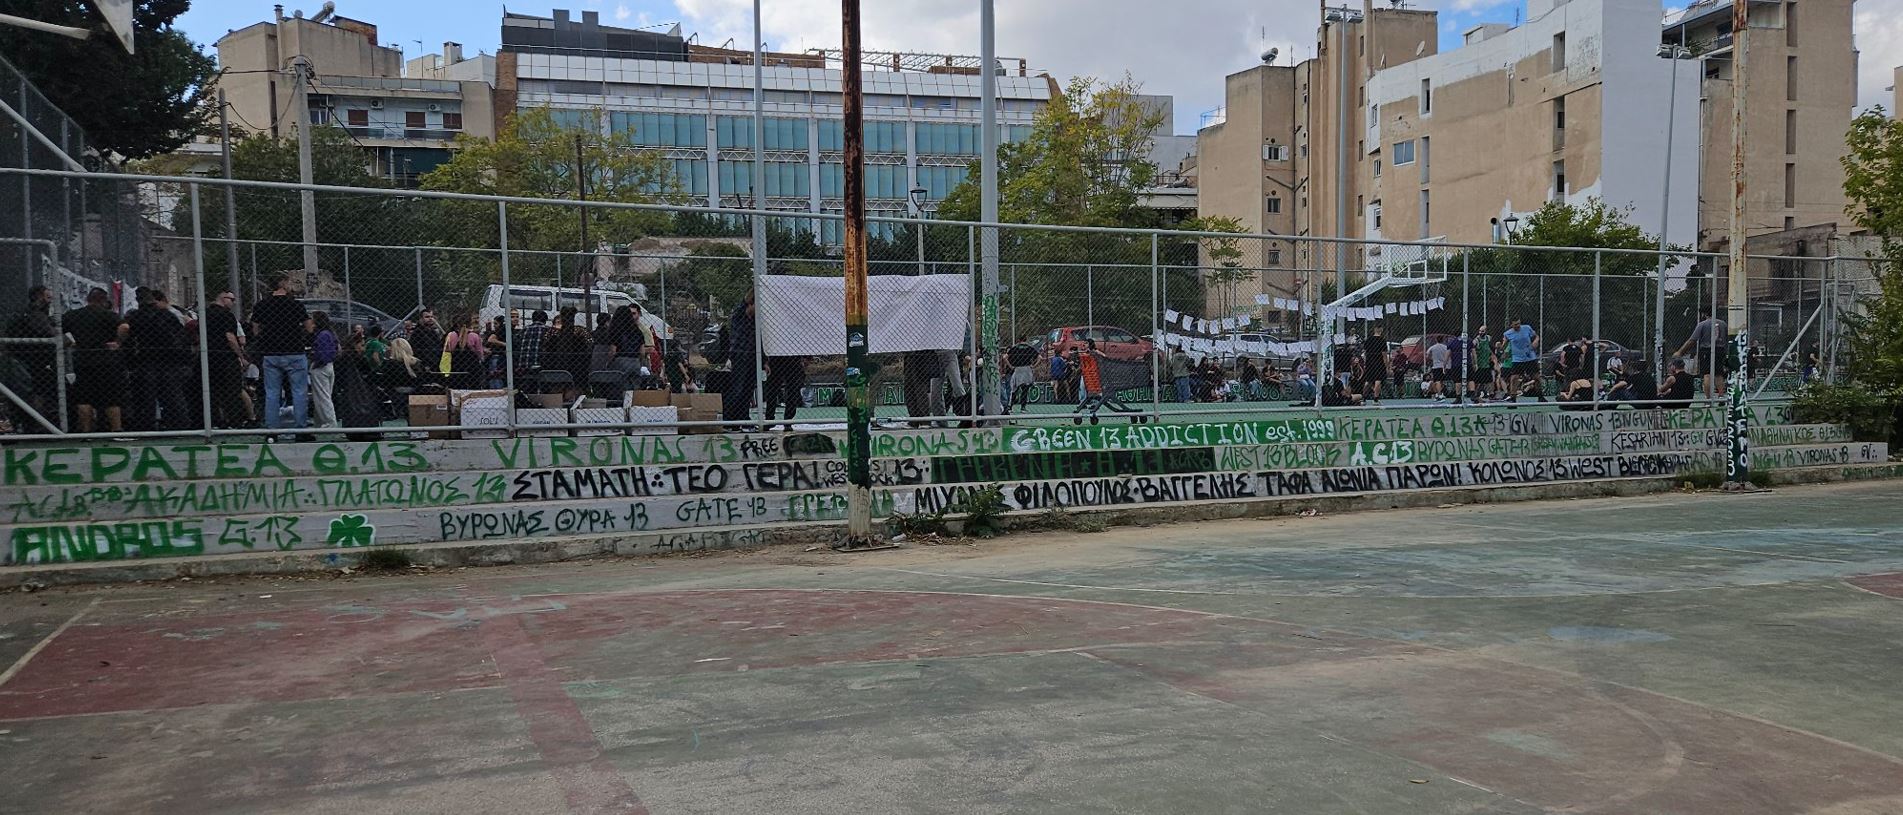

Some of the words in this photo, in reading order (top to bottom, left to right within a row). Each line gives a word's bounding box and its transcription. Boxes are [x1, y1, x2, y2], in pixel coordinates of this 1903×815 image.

[1010, 428, 1092, 452] GREEN
[1099, 426, 1120, 449] 13
[1125, 421, 1259, 448] ADDICTION
[1302, 419, 1334, 440] 1999
[1338, 416, 1426, 441] ΚΕΡΑΤΕΑ
[1549, 413, 1603, 433] VIRONAS
[4, 443, 294, 485] ΚΕΡΑΤΕΑ
[492, 436, 686, 469] VIRONAS
[702, 435, 738, 463] 13
[624, 502, 649, 530] 13
[676, 497, 742, 522] GATE
